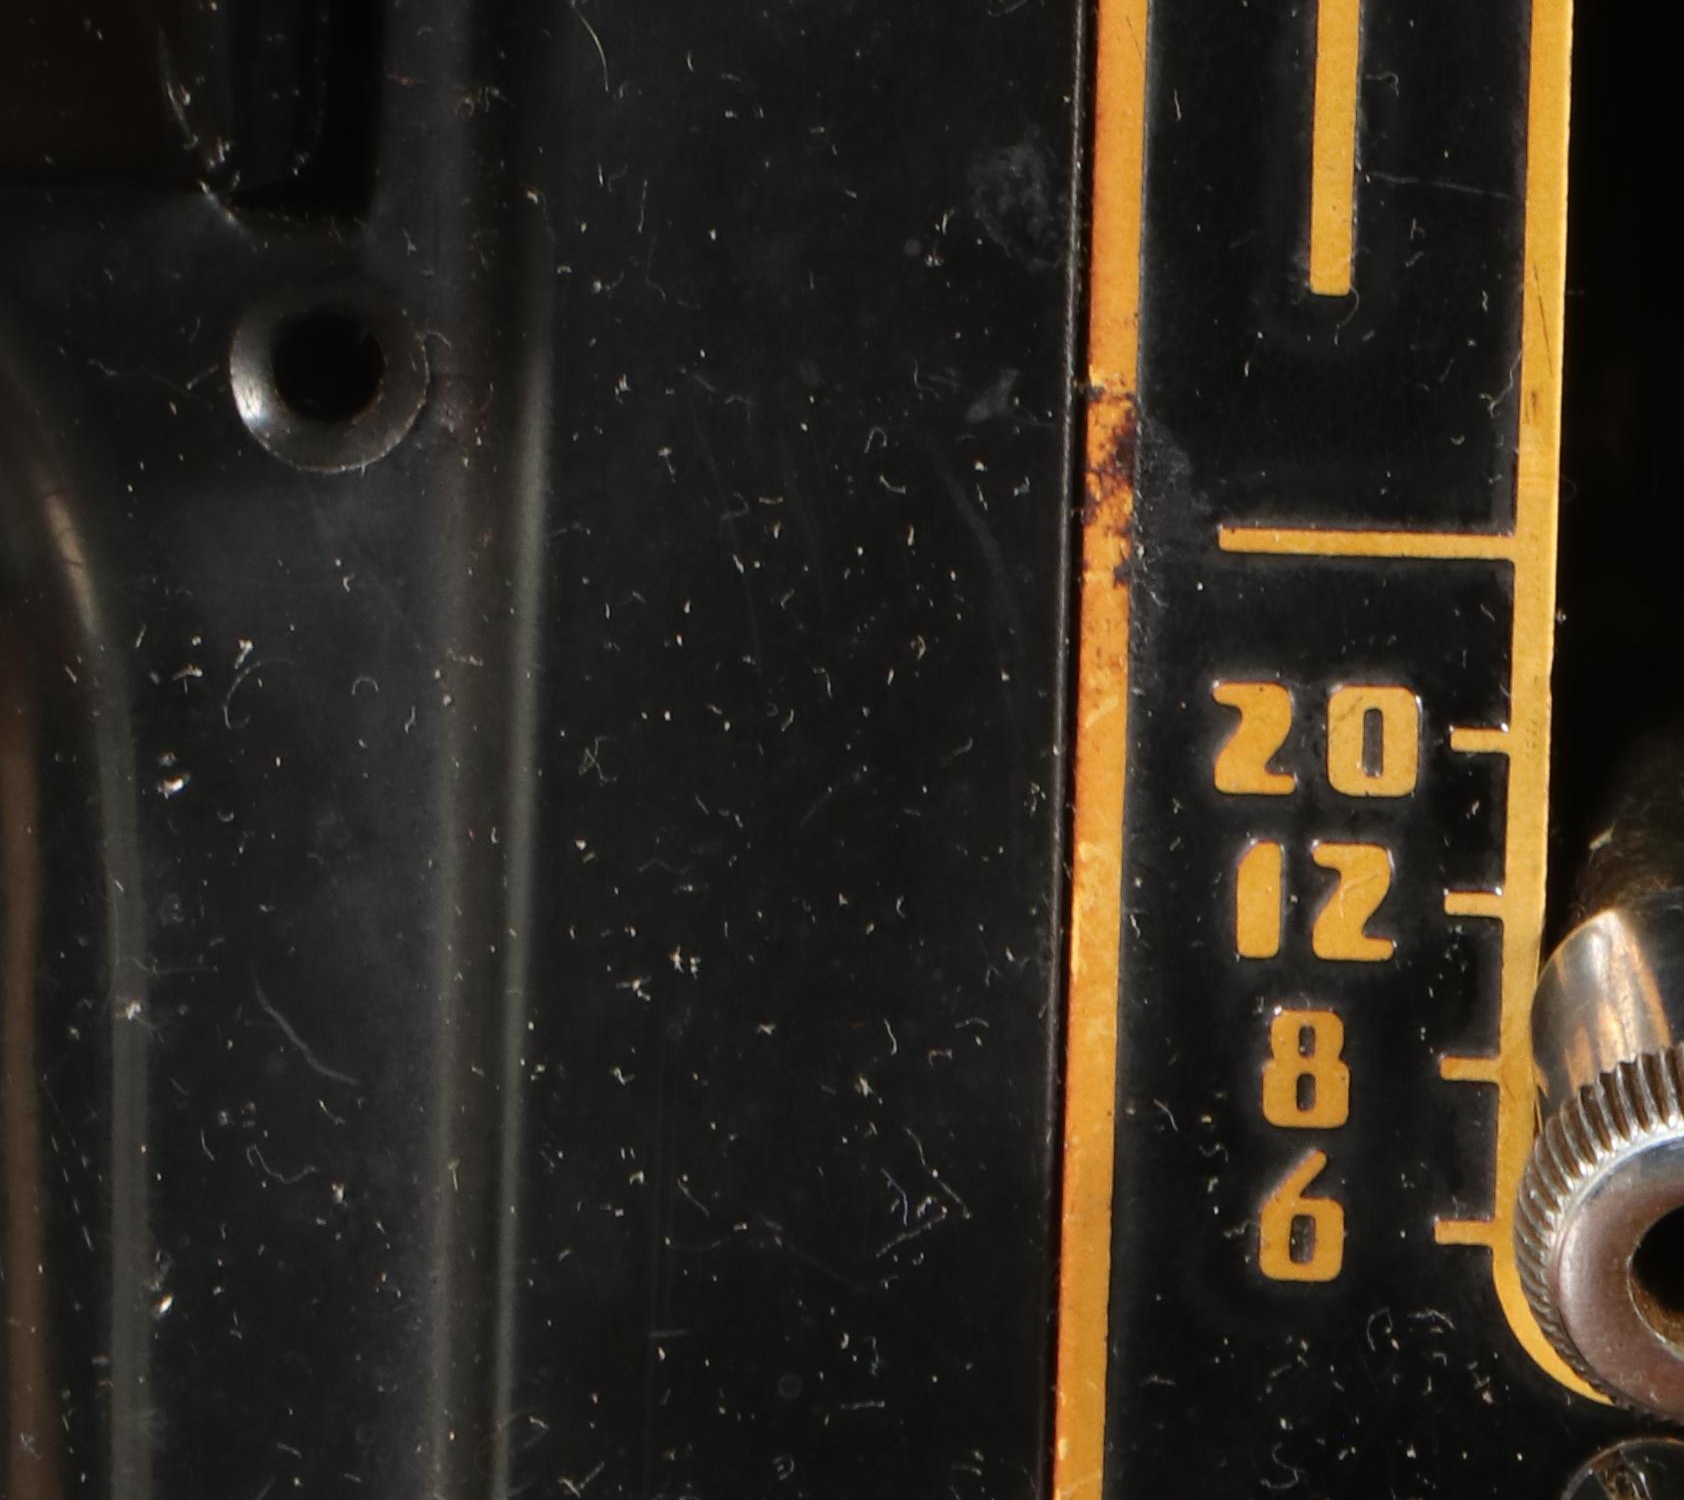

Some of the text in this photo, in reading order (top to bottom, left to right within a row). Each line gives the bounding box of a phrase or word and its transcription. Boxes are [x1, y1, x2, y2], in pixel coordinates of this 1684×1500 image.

[1211, 680, 1422, 797] 20
[1235, 839, 1397, 962] 12
[1262, 1008, 1350, 1128] 8
[1258, 1149, 1345, 1282] 6
